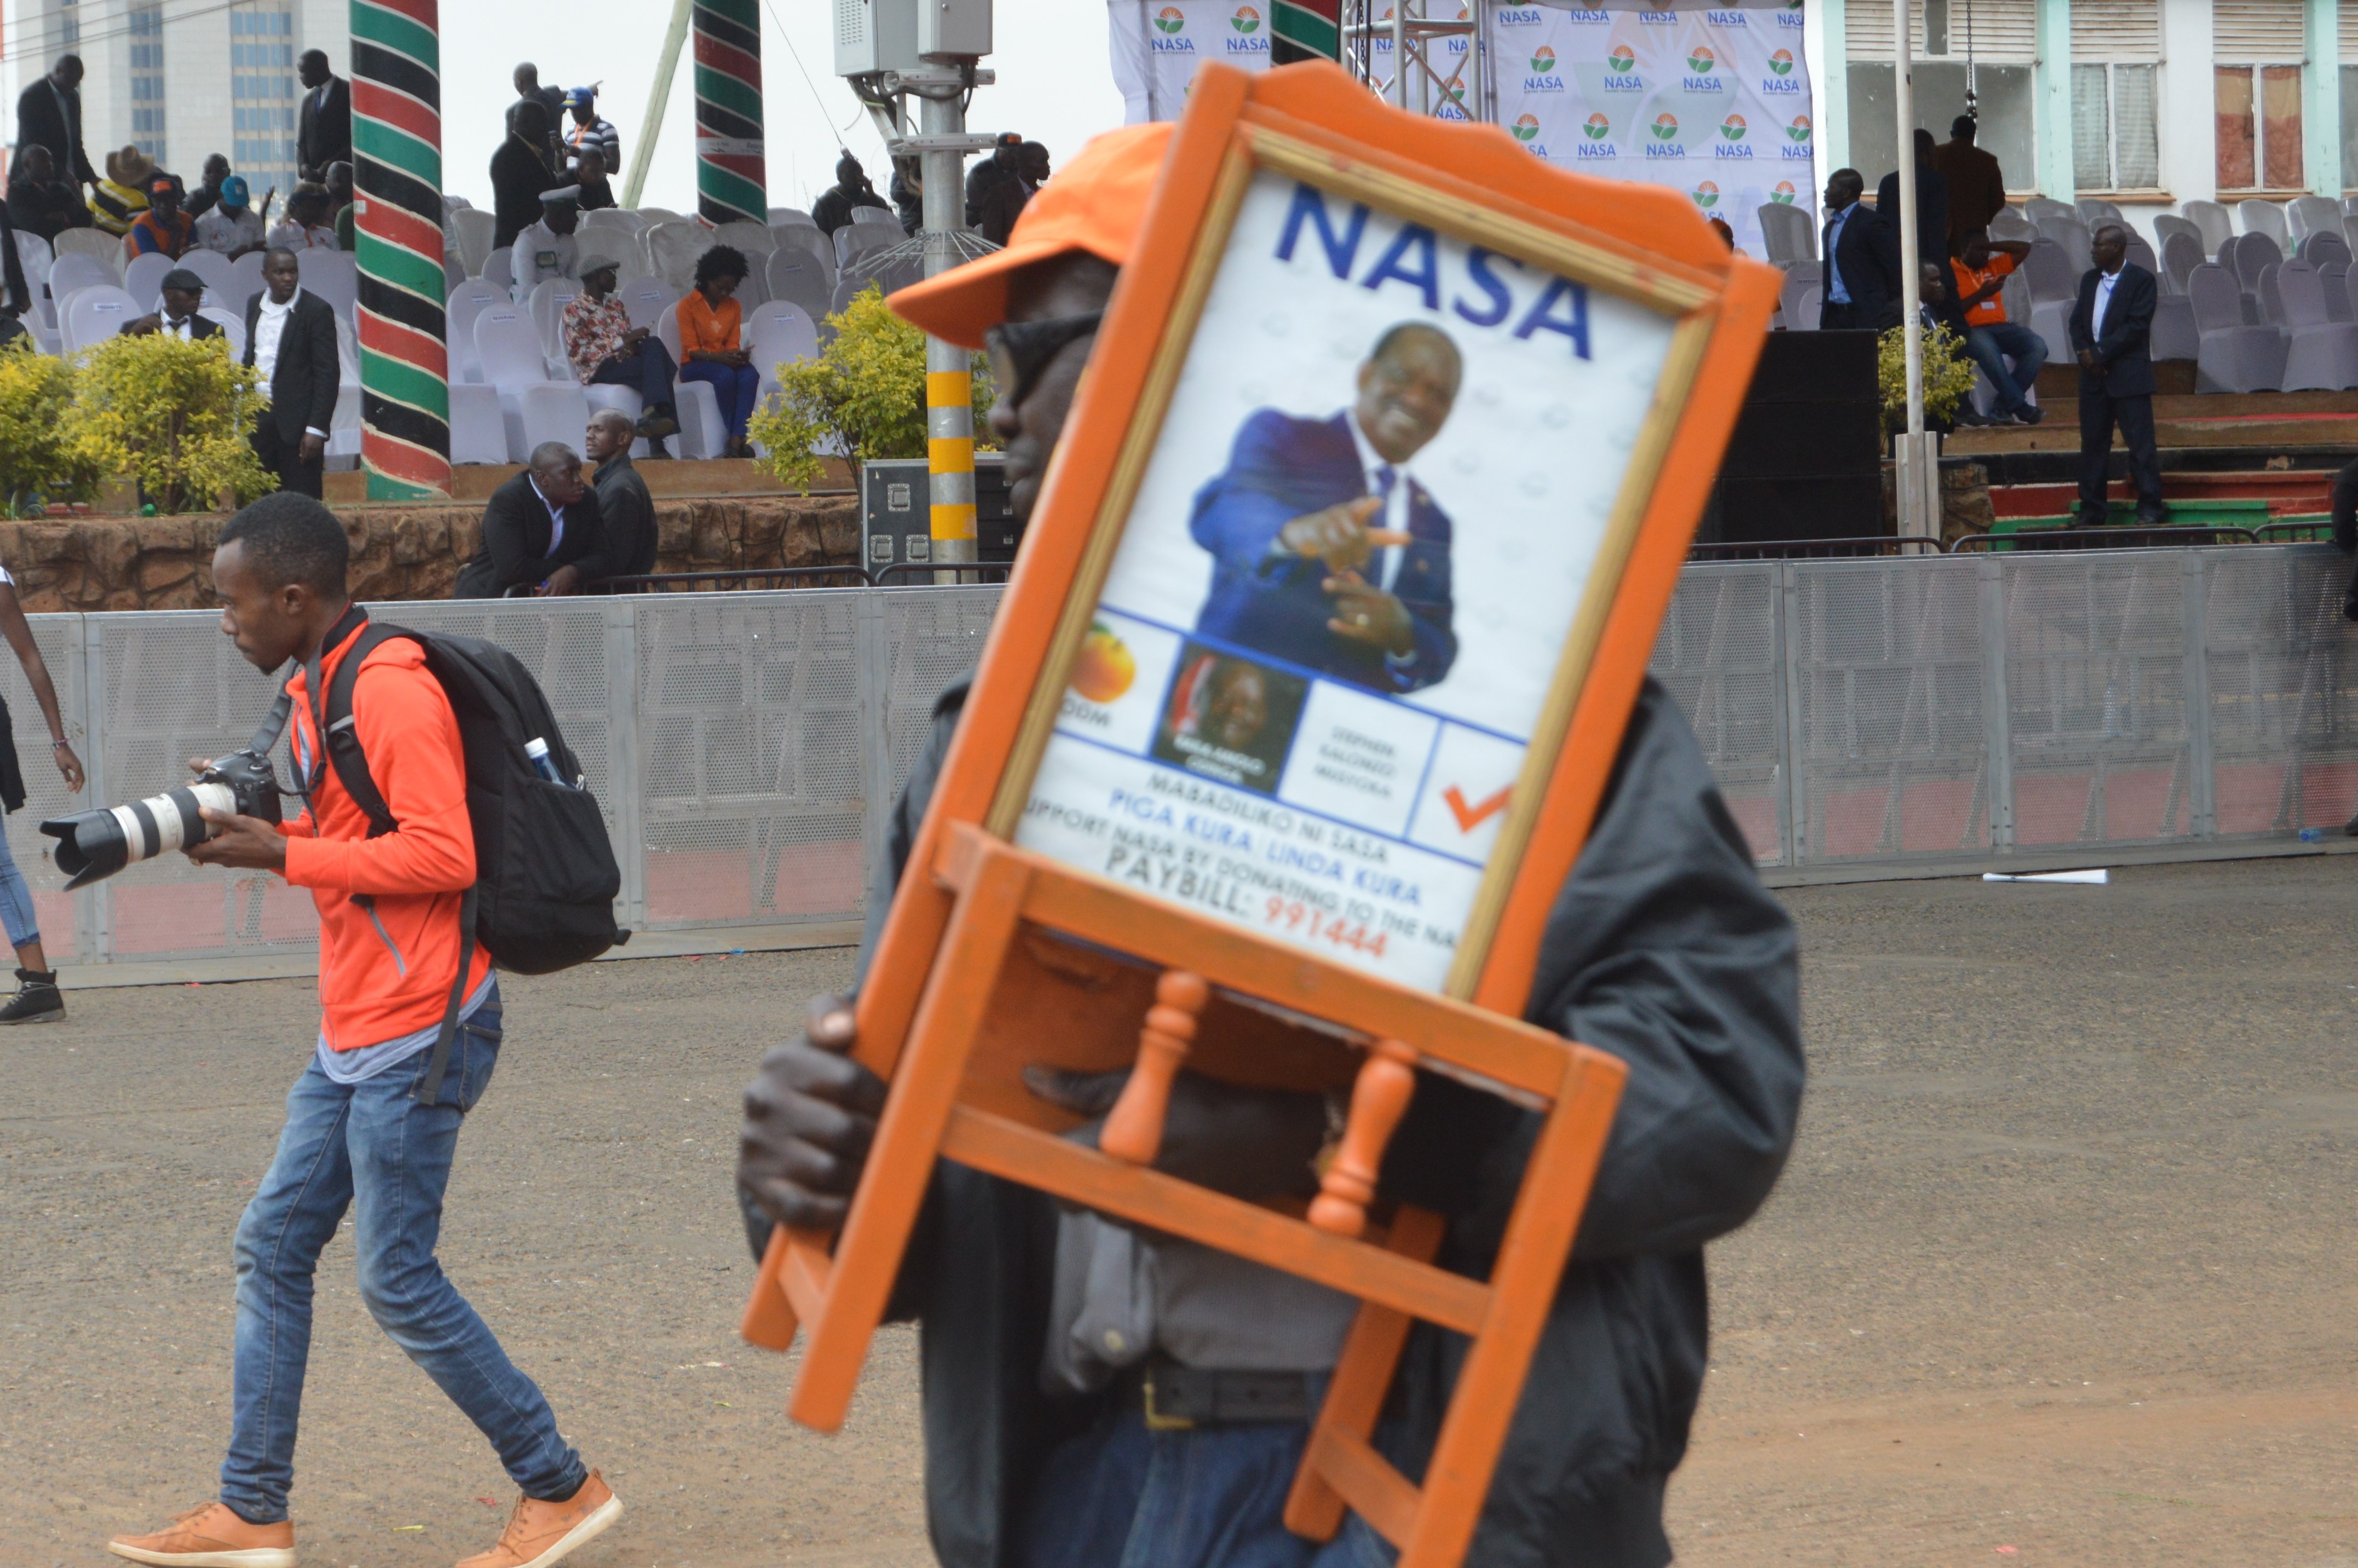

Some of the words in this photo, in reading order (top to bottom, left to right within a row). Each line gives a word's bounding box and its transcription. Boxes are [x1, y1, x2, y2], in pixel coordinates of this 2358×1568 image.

[1500, 10, 1542, 23] NASA
[1570, 10, 1610, 21] NASA
[1639, 10, 1677, 22] NASA
[1708, 11, 1746, 24] NASA
[1151, 37, 1195, 50] NASA
[1226, 37, 1270, 50] NASA
[1524, 76, 1564, 90] NASA
[1605, 76, 1642, 89] NASA
[1684, 77, 1722, 90] NASA
[1763, 79, 1800, 91] NASA
[1578, 143, 1616, 156] NASA
[1647, 143, 1685, 156] NASA
[1715, 144, 1753, 157] NASA
[1273, 180, 1594, 361] NASA
[1146, 773, 1294, 831] MABADILIKO
[1299, 820, 1320, 842] NI
[1331, 827, 1388, 863] SASA
[1108, 787, 1173, 827] PIGA
[1183, 812, 1252, 852] KURA
[1266, 838, 1344, 881] LINDA
[1352, 865, 1422, 907] KURA
[1026, 795, 1108, 835] UPPORT
[1112, 824, 1175, 858] NASA
[1183, 846, 1209, 866] BY
[1217, 856, 1340, 911] DONATING
[1346, 897, 1376, 923] TO
[1381, 908, 1419, 939] THE
[1105, 844, 1253, 918] PAYBILL:
[1265, 895, 1389, 959] 991444
